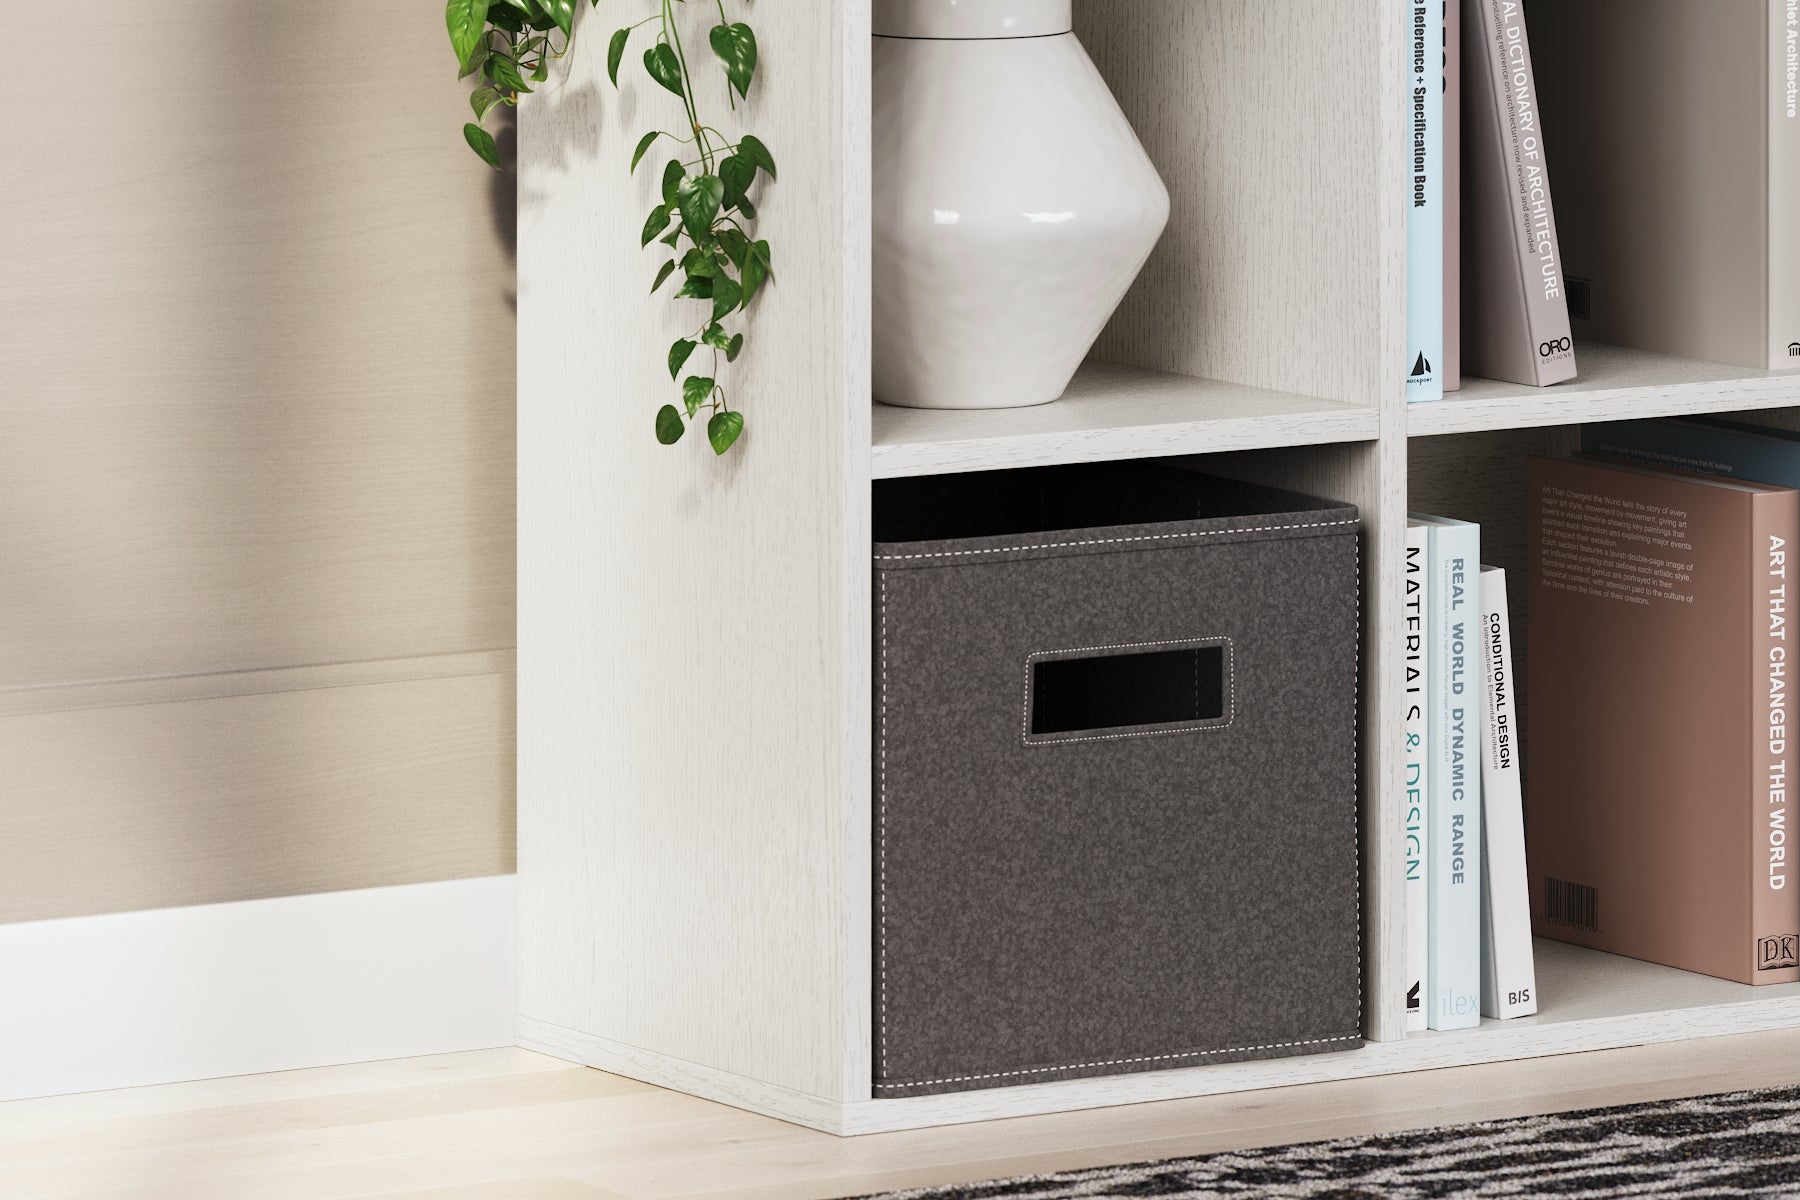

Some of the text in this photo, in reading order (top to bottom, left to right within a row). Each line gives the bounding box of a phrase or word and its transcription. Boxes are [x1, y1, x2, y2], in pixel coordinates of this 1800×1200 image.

[1415, 8, 1426, 73] Reference
[1417, 76, 1423, 84] +
[1498, 42, 1508, 80] reference
[1507, 26, 1534, 131] DICTIONARY
[1787, 29, 1798, 117] Architecture
[1505, 82, 1510, 92] on
[1413, 87, 1426, 172] Specification
[1506, 94, 1518, 143] architecture
[1523, 137, 1538, 160] OF
[1415, 176, 1426, 207] Book
[1517, 165, 1527, 194] revised
[1521, 196, 1529, 211] and
[1524, 213, 1536, 253] expanded
[1527, 166, 1559, 300] ARCHITECTURE
[1540, 337, 1570, 356] ORO
[1483, 615, 1488, 624] An
[1490, 613, 1510, 768] CONDITIONAL DESIGN
[1453, 558, 1464, 884] REAL WORLD DYNAMIC RANGE
[1770, 536, 1785, 889] ART THAT CHANGED THE WORLD
[1764, 937, 1794, 962] DK
[1508, 989, 1530, 1006] BIS
